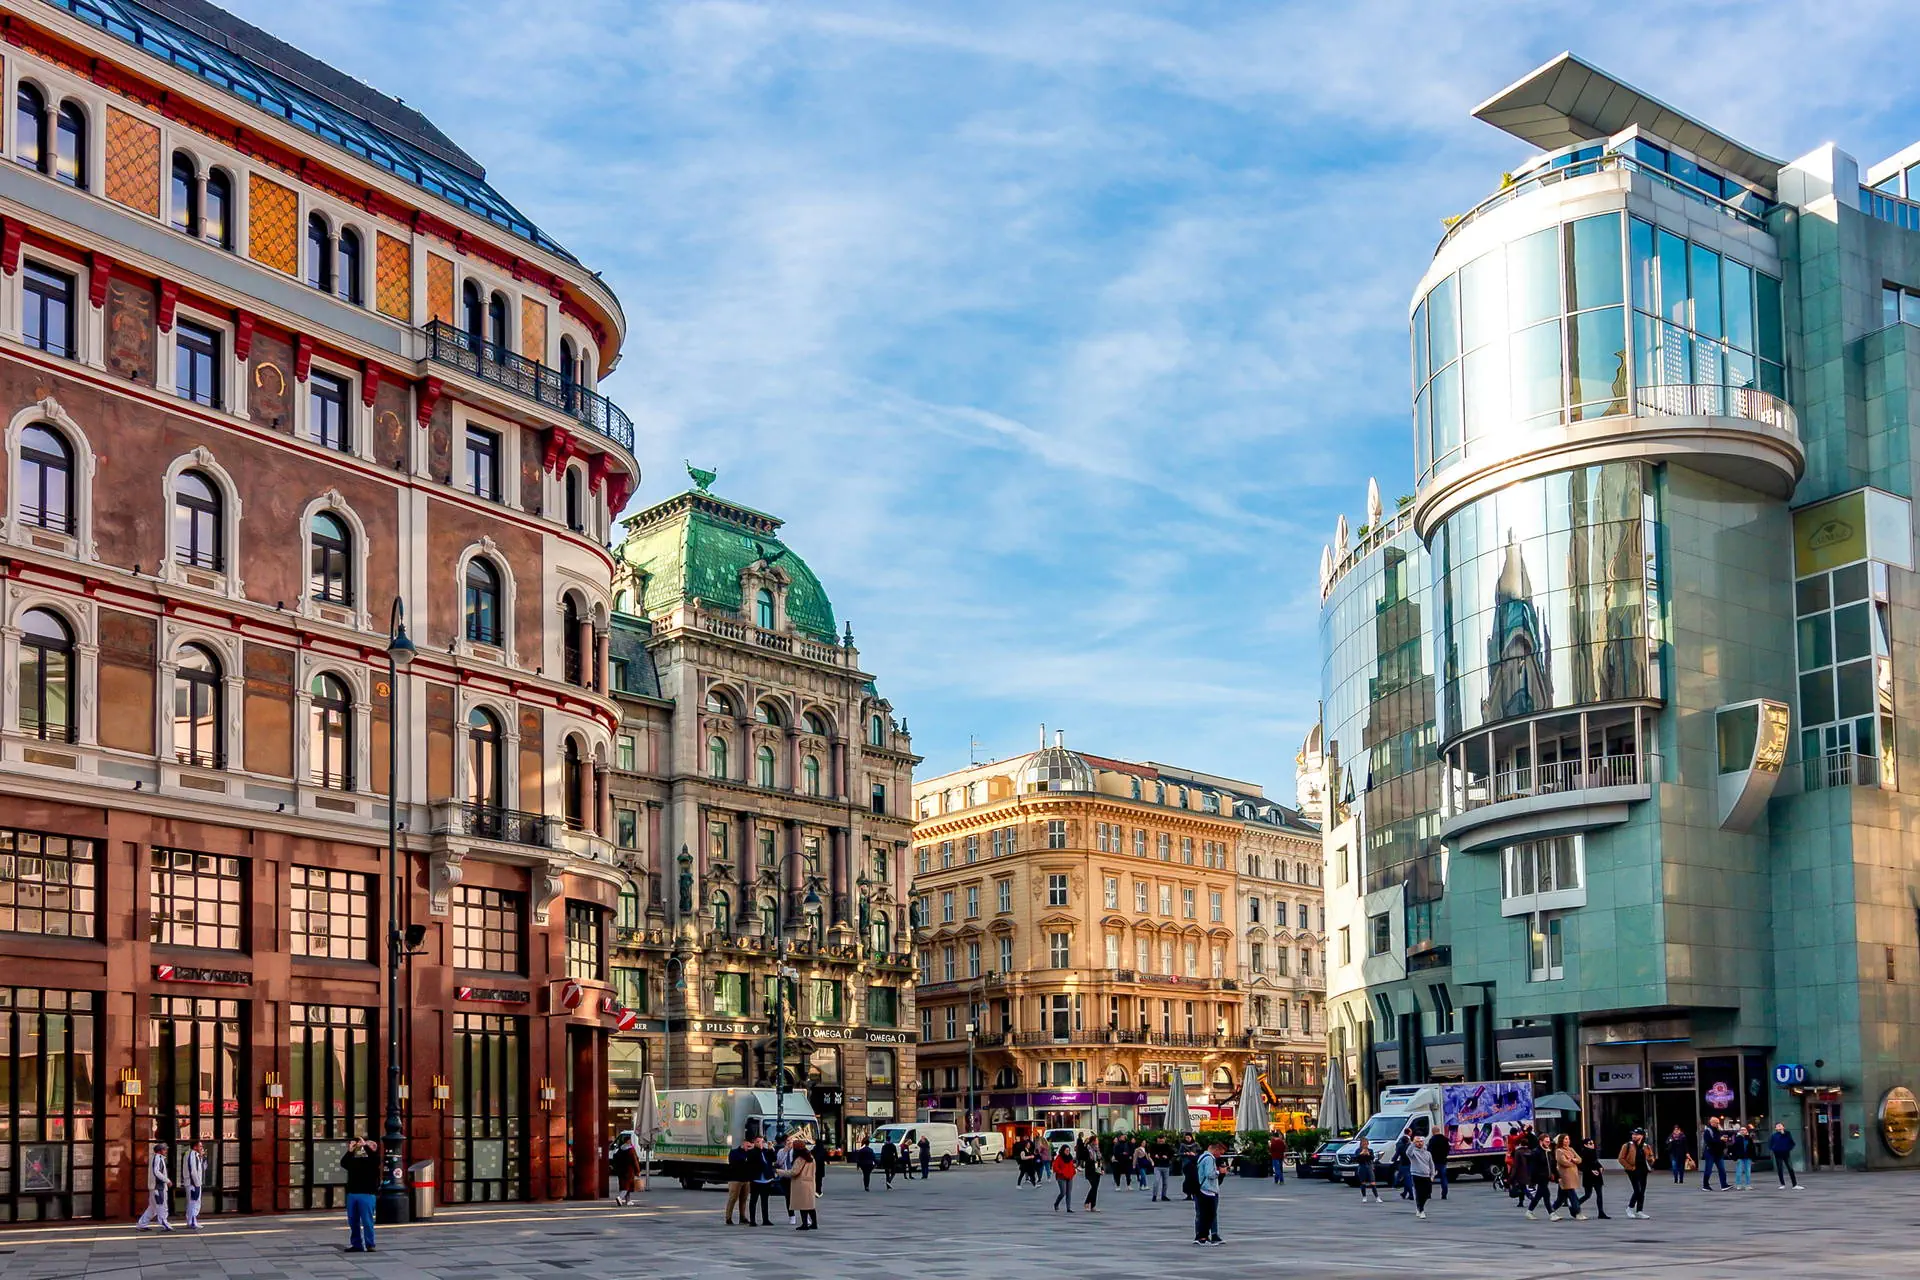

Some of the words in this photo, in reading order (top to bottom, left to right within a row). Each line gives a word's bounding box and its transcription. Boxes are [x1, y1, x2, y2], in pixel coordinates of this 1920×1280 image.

[706, 1023, 748, 1033] PILSTL
[813, 1029, 842, 1038] OMEGA
[870, 1034, 897, 1043] OMEGA
[1611, 1072, 1634, 1080] ONYX
[1776, 1068, 1790, 1083] U
[1795, 1068, 1804, 1082] U
